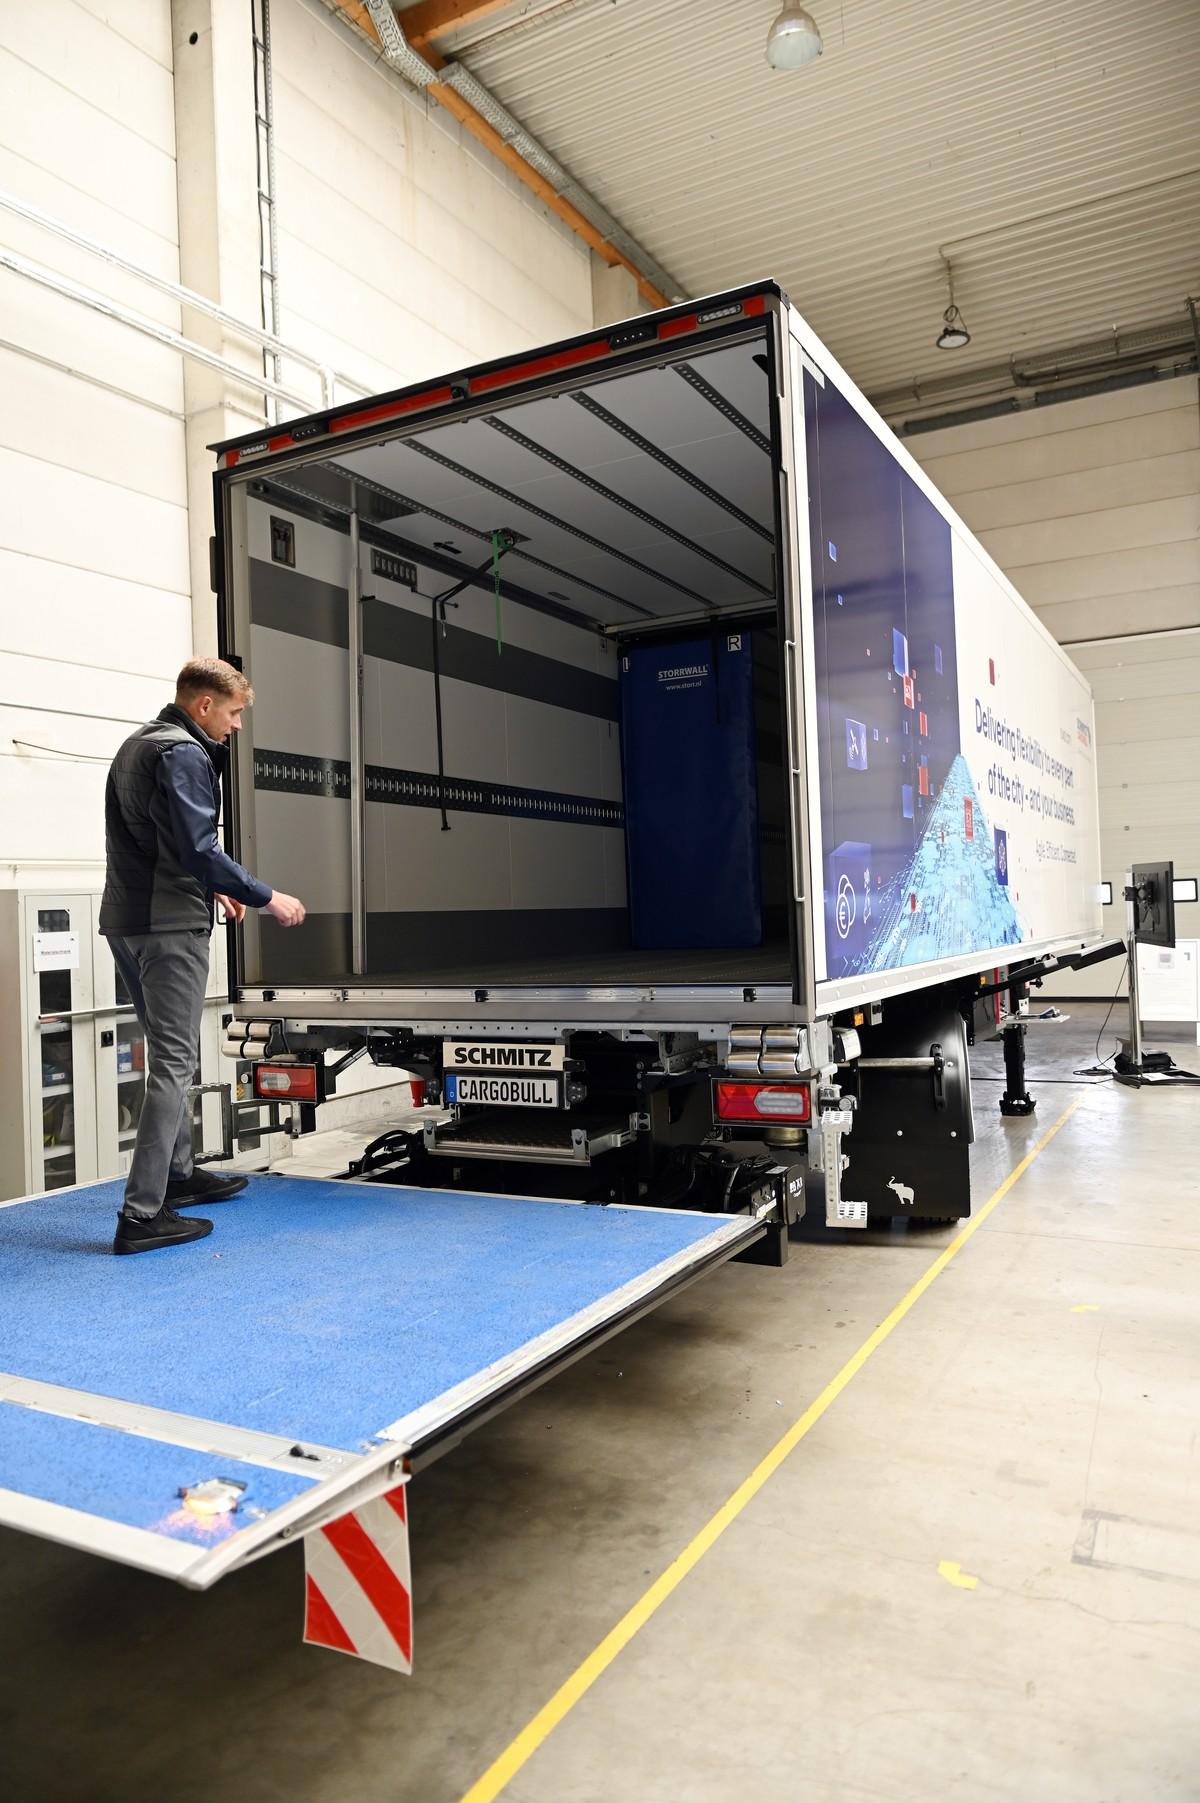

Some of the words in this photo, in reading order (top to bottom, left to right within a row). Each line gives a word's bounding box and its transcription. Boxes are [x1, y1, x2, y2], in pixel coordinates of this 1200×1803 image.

[728, 636, 740, 650] R
[658, 665, 708, 679] STORRWALL
[975, 698, 1016, 761] Delivering
[988, 763, 996, 795] of
[997, 766, 1010, 801] the
[1011, 774, 1024, 812] city
[1029, 786, 1040, 812] and
[454, 1047, 552, 1066] SCHMITZ
[458, 1079, 553, 1103] CARGOBULL
